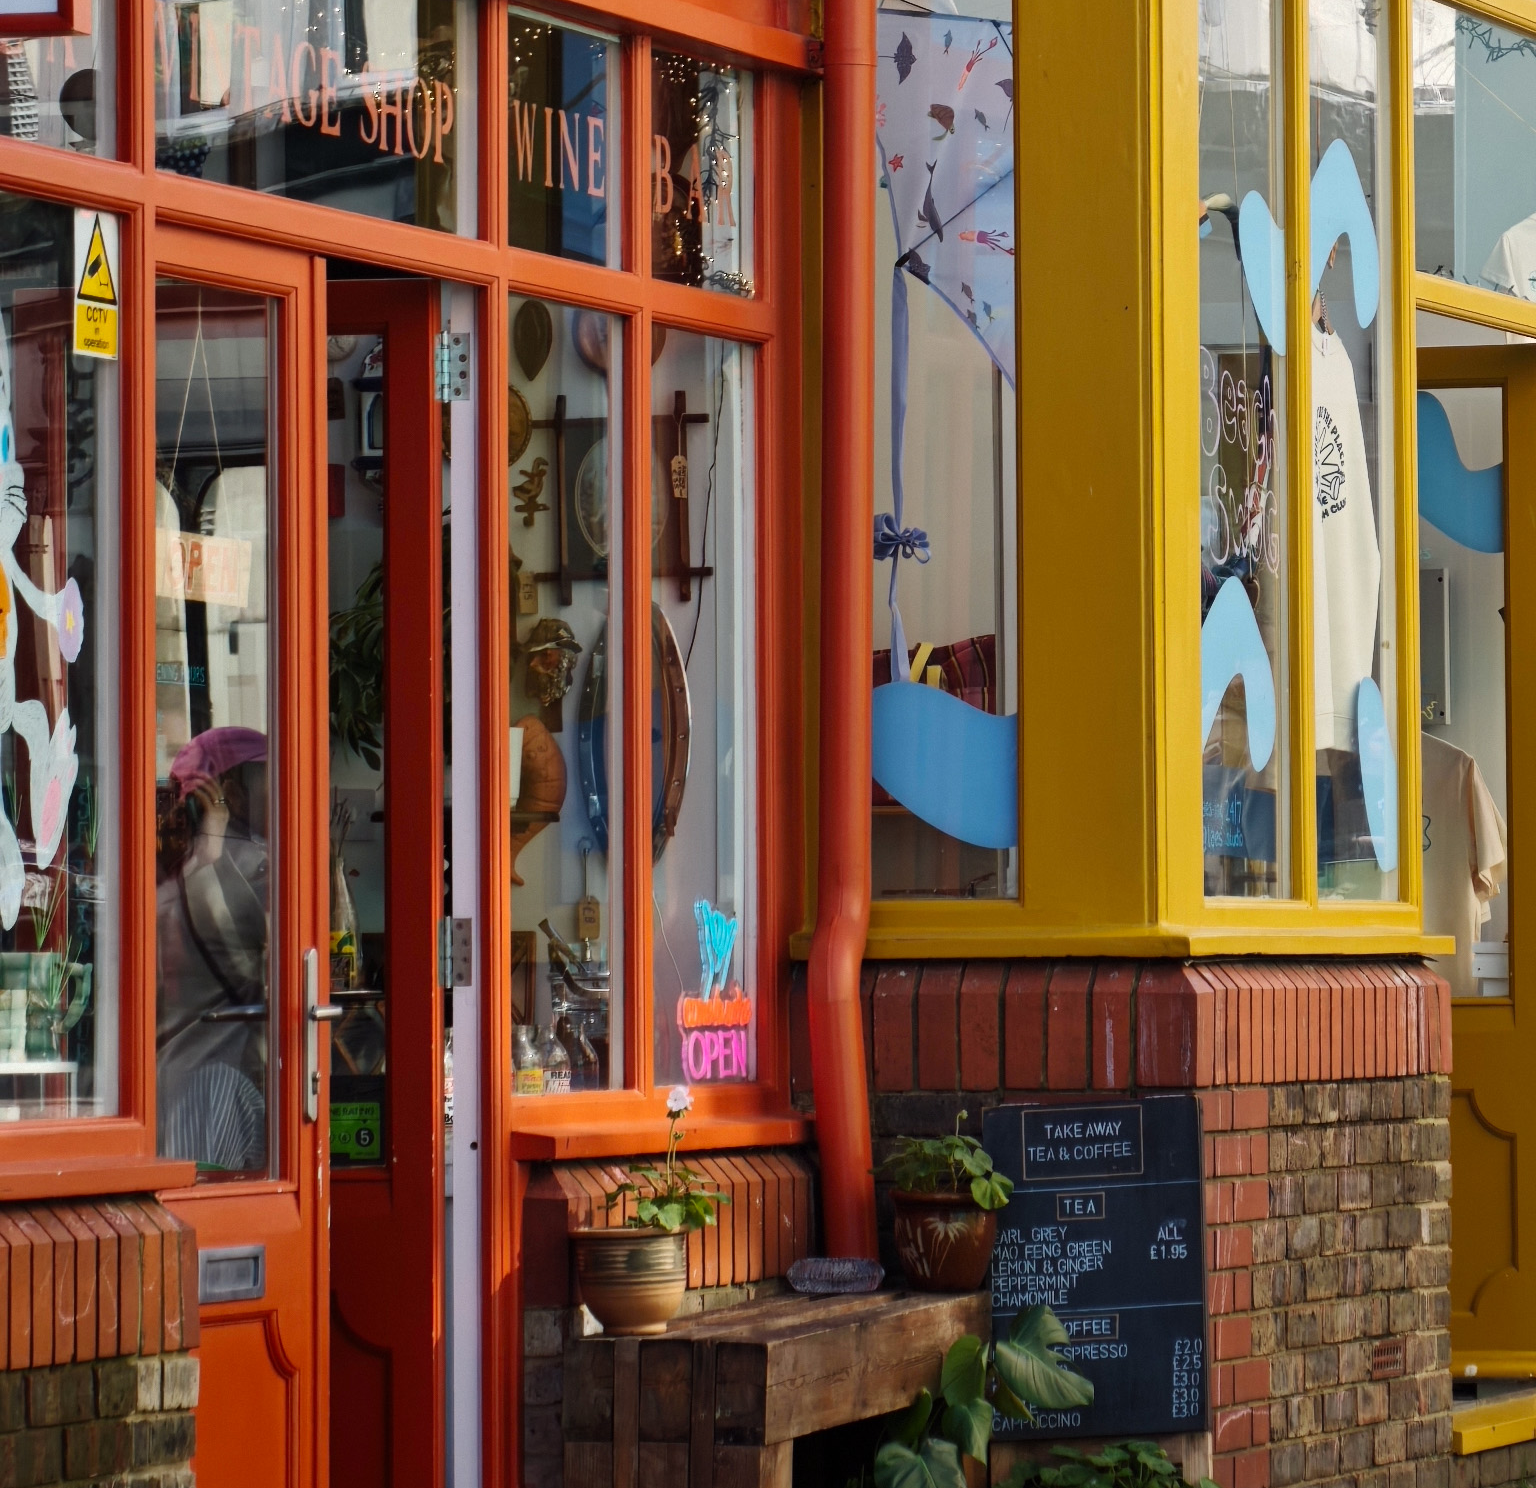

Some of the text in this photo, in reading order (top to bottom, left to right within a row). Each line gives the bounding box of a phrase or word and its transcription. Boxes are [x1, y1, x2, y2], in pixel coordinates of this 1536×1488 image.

[359, 59, 455, 165] SHOP
[512, 98, 606, 199] WINE
[652, 133, 738, 229] BAR
[86, 305, 109, 325] CCTV
[83, 336, 110, 350] operation
[1200, 344, 1279, 473] Beach
[168, 537, 239, 595] OPEN
[688, 1029, 748, 1081] OPEN
[1044, 1121, 1122, 1140] TAKE AWAY
[1027, 1141, 1133, 1162] TEA & COFFEE
[1063, 1199, 1097, 1215] TEA
[1031, 1225, 1068, 1242] GREY
[1157, 1225, 1183, 1242] ALL
[991, 1239, 1112, 1260] MAO FENG GREEN
[1150, 1244, 1188, 1260] £1.95
[991, 1255, 1104, 1277] LEMON & GINGER
[991, 1273, 1080, 1293] PEPPERMINT
[991, 1289, 1069, 1308] CHAMOMILE
